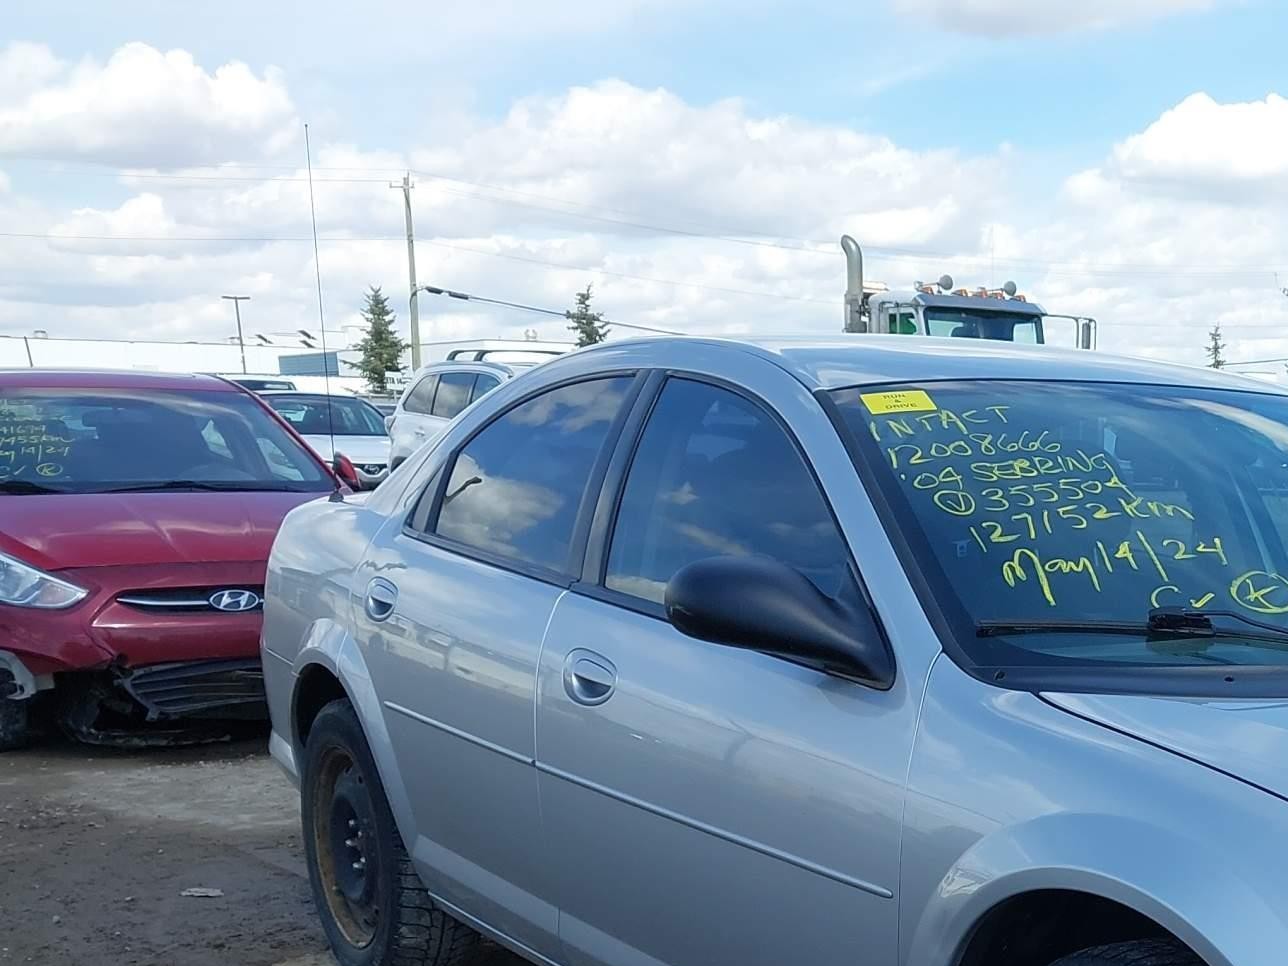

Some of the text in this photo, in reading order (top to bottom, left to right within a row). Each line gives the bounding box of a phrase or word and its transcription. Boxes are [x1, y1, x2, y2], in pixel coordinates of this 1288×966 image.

[869, 405, 1011, 442] INTACT
[884, 402, 918, 410] DRIVE
[887, 430, 1062, 470] 12008666
[969, 449, 1114, 482] SEBRING
